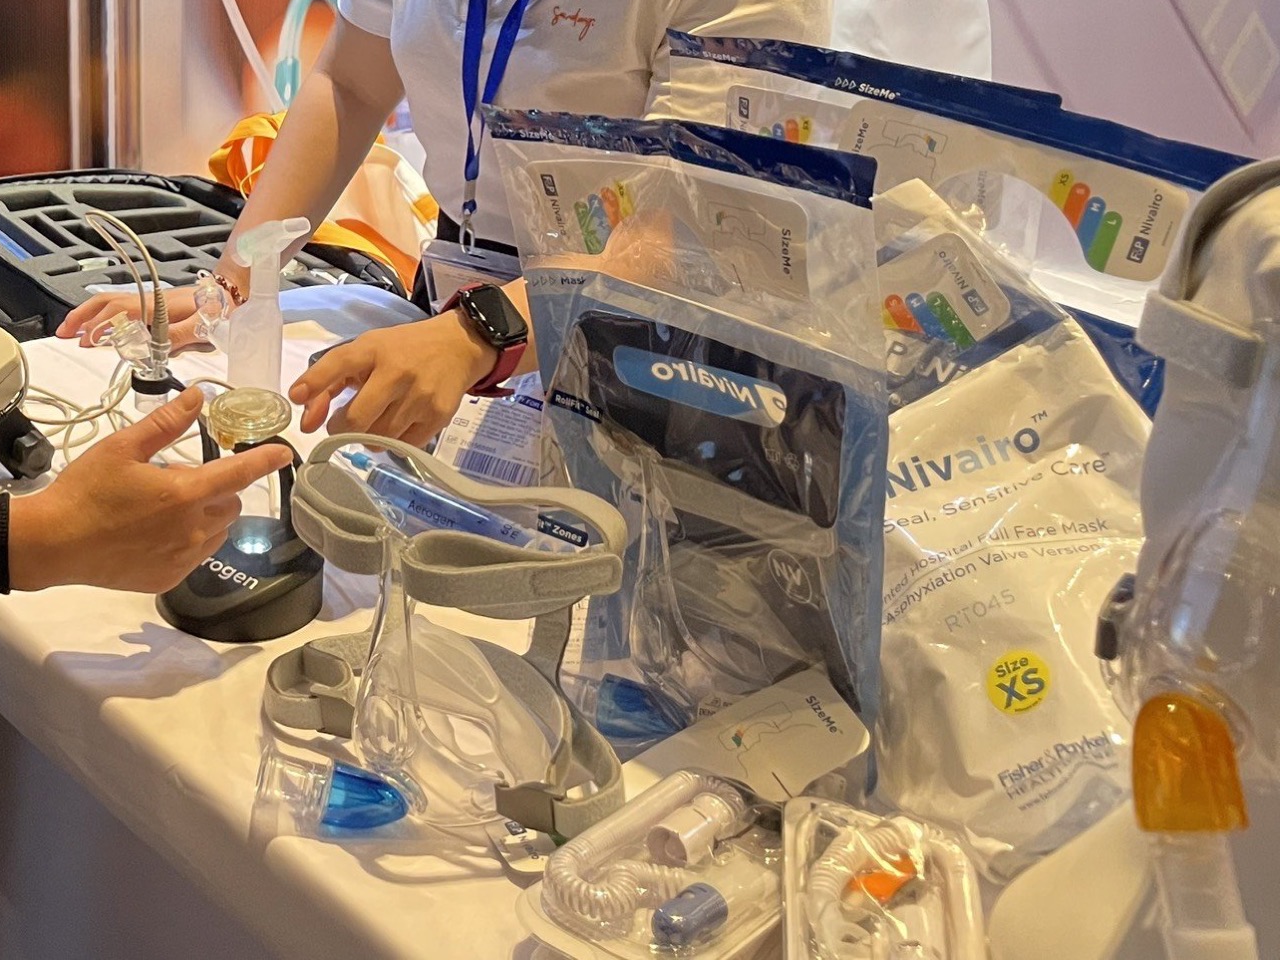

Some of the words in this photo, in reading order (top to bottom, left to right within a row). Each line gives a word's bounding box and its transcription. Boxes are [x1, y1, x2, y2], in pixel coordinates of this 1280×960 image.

[1058, 172, 1070, 186] XS
[552, 525, 582, 543] Zones
[910, 538, 972, 577] Hospital
[1014, 524, 1057, 539] Face
[1061, 517, 1108, 535] Mask
[201, 556, 259, 590] rogen
[995, 657, 1029, 678] Size
[995, 667, 1045, 710] XS
